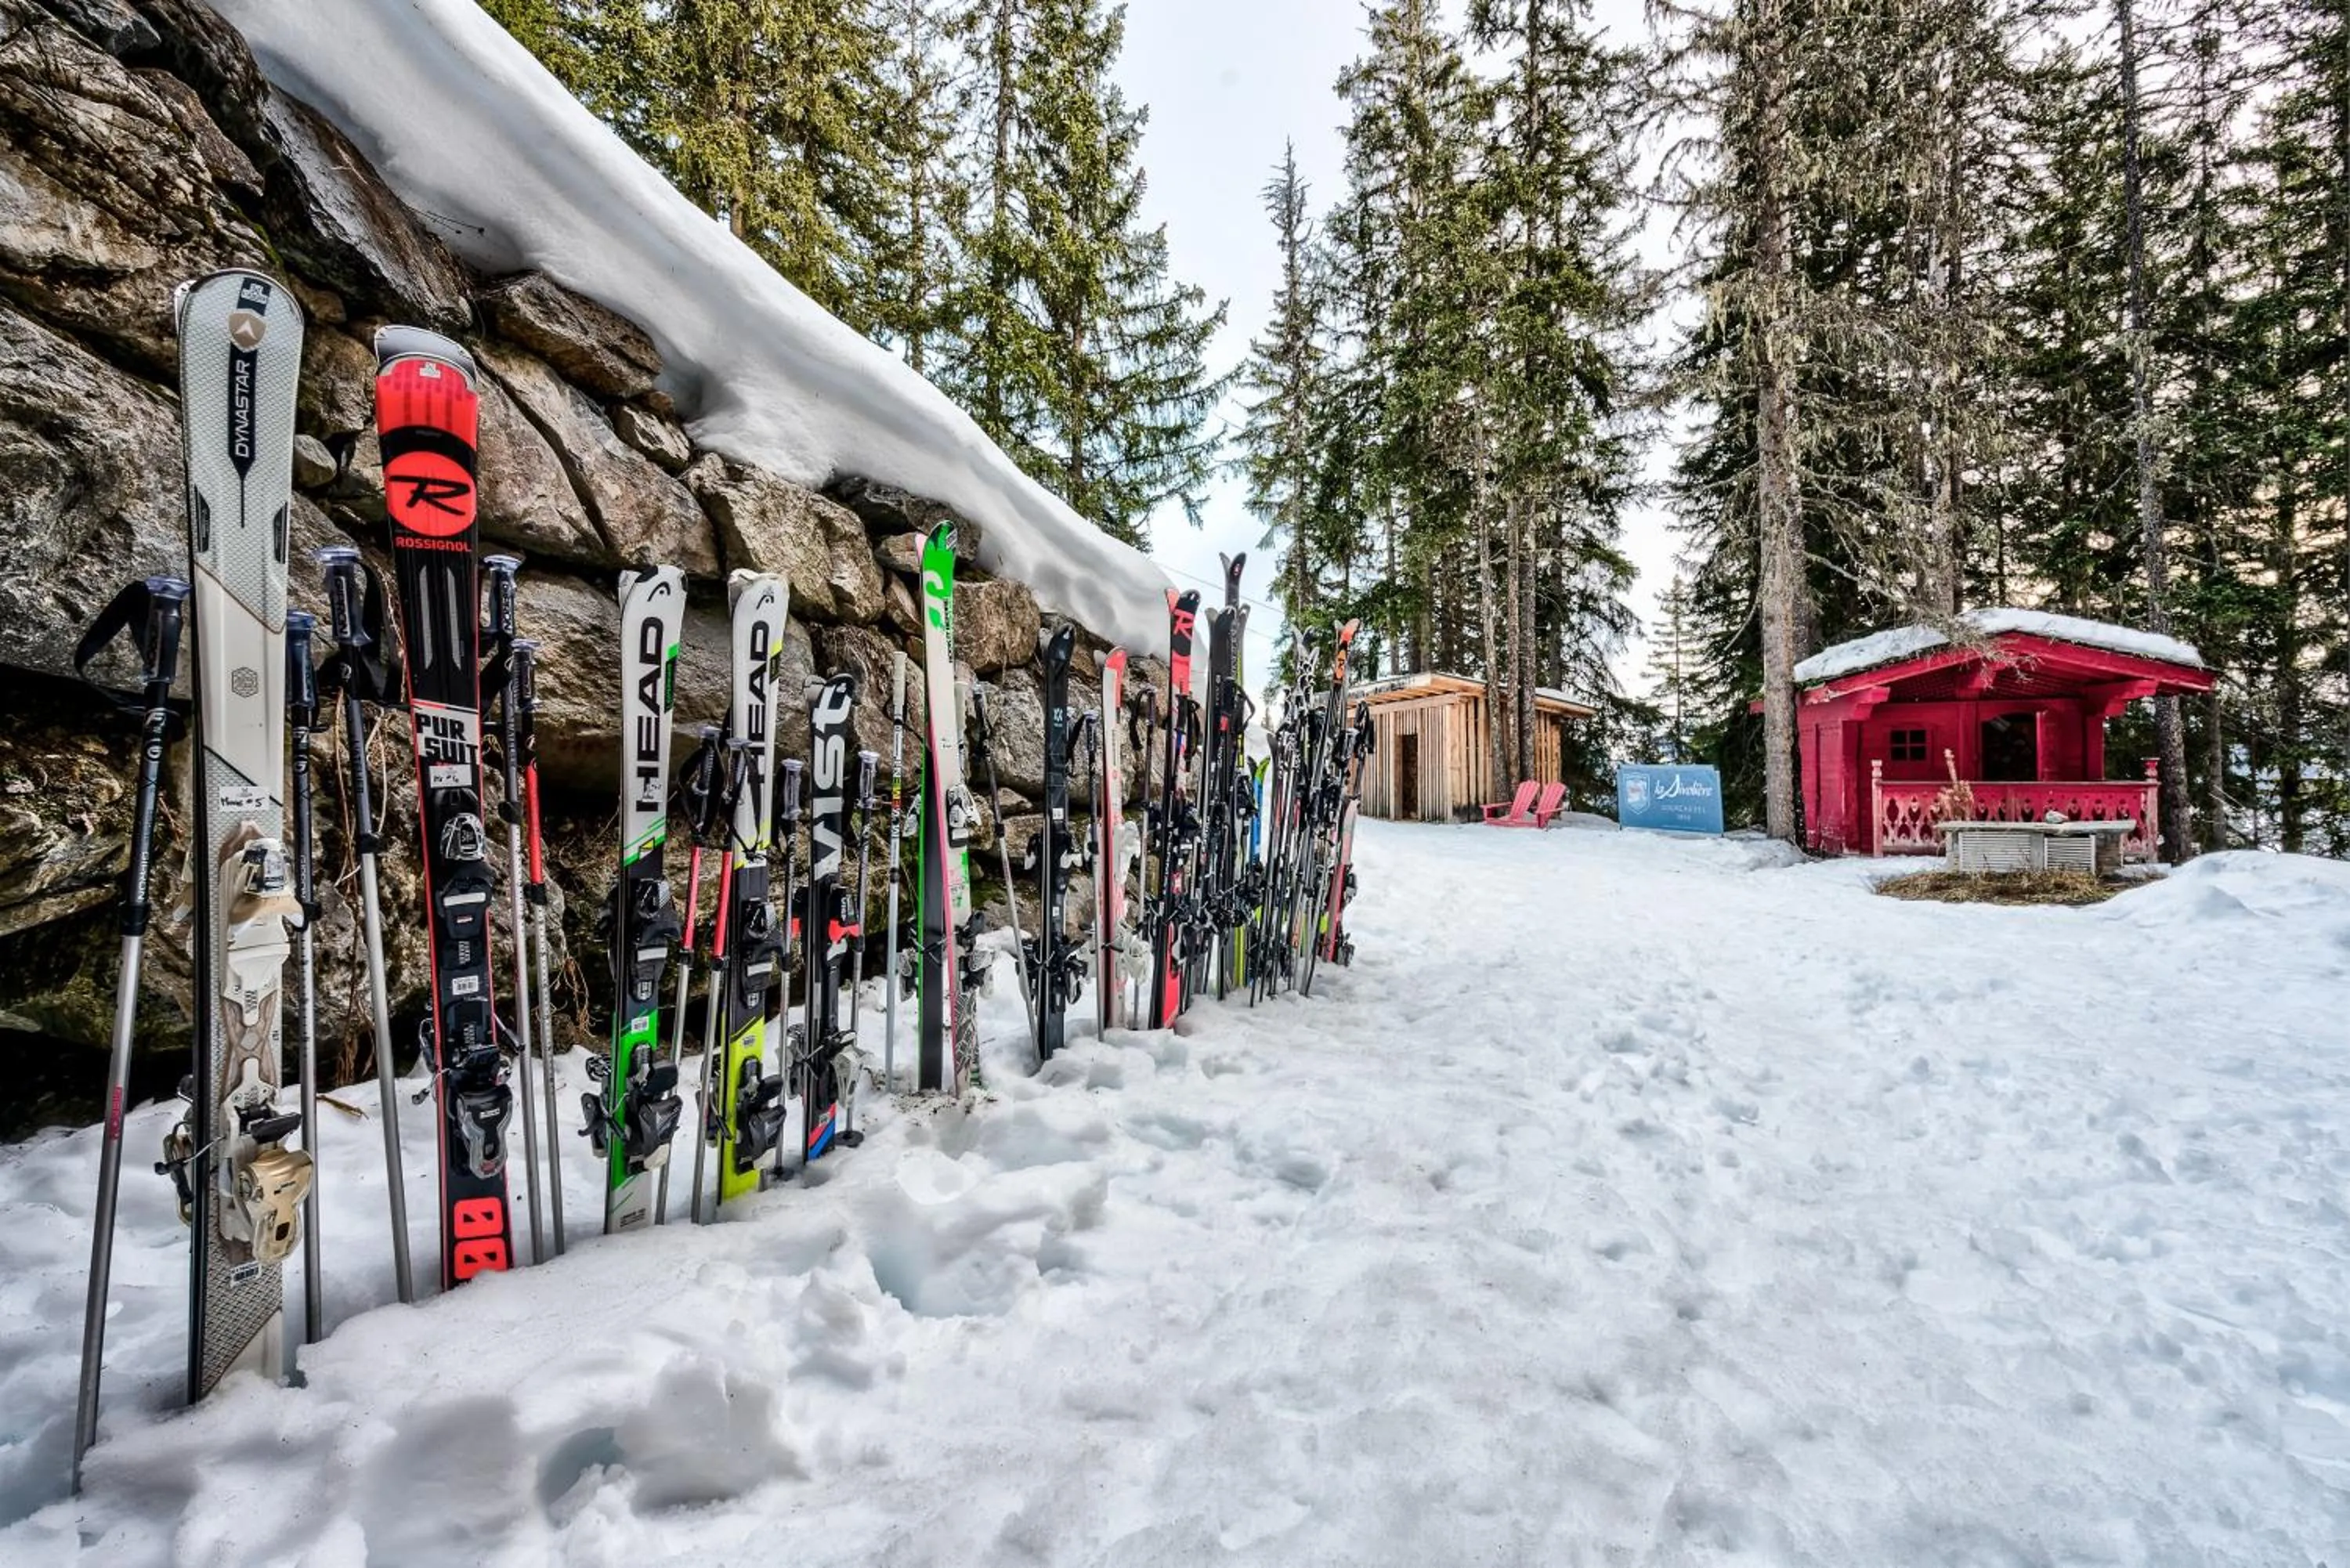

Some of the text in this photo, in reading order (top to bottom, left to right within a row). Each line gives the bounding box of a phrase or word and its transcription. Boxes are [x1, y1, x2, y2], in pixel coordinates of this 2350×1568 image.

[235, 359, 250, 458] DYNASTAR
[390, 475, 471, 516] R
[395, 536, 472, 553] ROSSIGNOL
[415, 713, 467, 742] PUR
[635, 616, 663, 811] HEAD
[424, 737, 478, 765] SUIT
